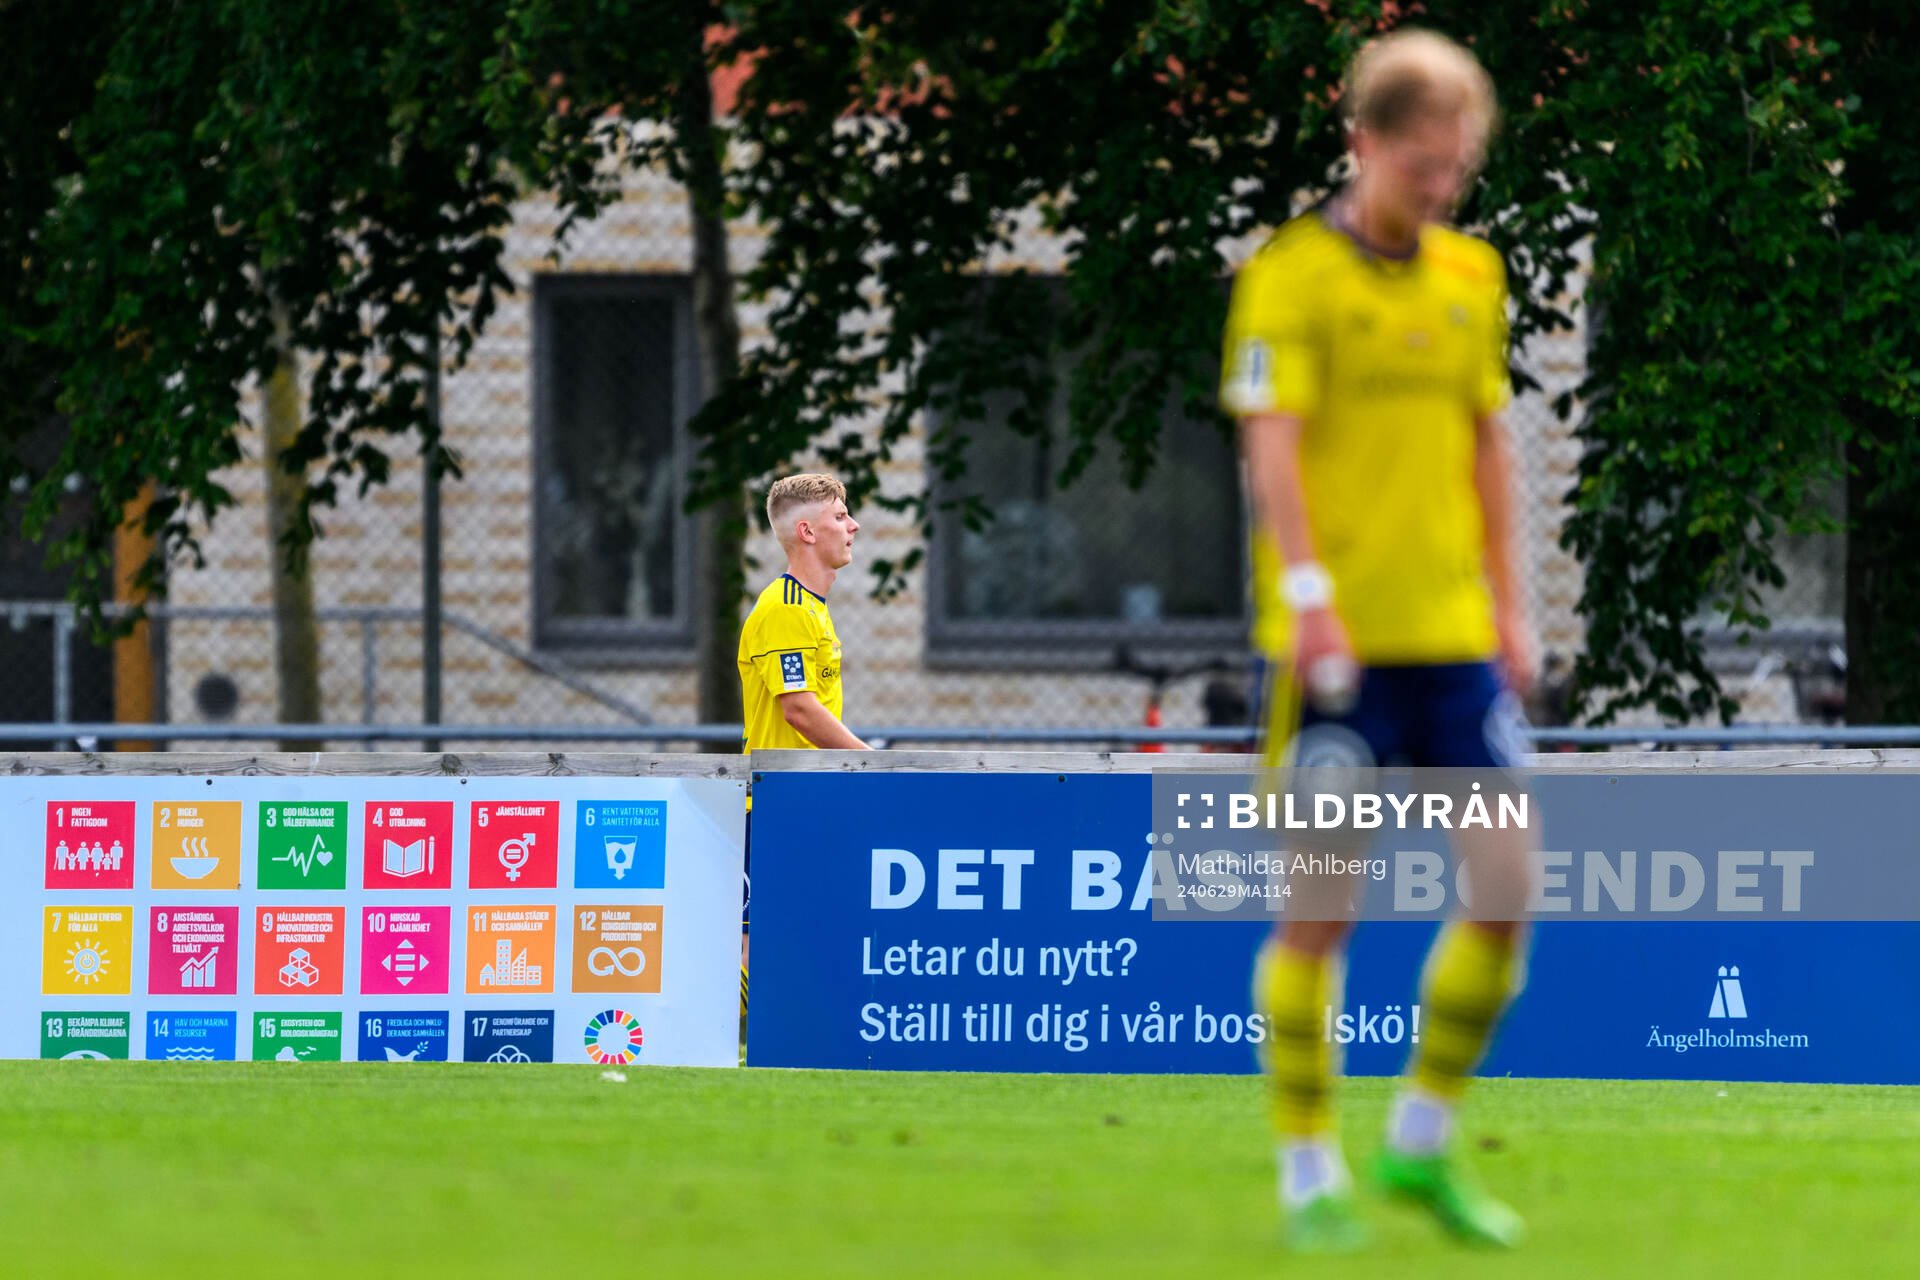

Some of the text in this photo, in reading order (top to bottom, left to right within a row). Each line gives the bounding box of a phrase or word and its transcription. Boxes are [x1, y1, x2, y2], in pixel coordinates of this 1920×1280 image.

[56, 808, 63, 827] 1
[72, 808, 91, 816] INGEN
[160, 808, 170, 827] 2
[266, 808, 276, 827] 3
[283, 806, 334, 816] GOD HÄLSA OCH
[372, 808, 383, 827] 4
[390, 808, 403, 816] GOD
[478, 808, 488, 827] 5
[496, 806, 545, 816] JÄMSTÄLLDHET
[586, 808, 595, 826] 6
[71, 818, 108, 827] FATTIGDOM
[602, 818, 629, 826] SANITET
[643, 818, 660, 826] ALLA
[871, 832, 1814, 912] DET BÄST BENDET
[52, 912, 61, 932] 7
[157, 912, 168, 932] 8
[173, 912, 214, 921] ANSTÄNDIGA
[262, 912, 273, 932] 9
[277, 912, 304, 922] HÅLLBAR
[368, 913, 386, 932] 10
[473, 912, 486, 932] 11
[580, 912, 596, 931] 12
[173, 924, 224, 932] ARBETSVILLKOR
[172, 934, 224, 942] OCH EKONOMISK
[276, 934, 325, 942] INFRASTRUKTUR
[172, 944, 201, 953] TILLVÄXT
[862, 937, 1138, 985] Letar du nytt?
[46, 1018, 63, 1037] 13
[68, 1017, 99, 1026] BEKÄMPA
[154, 1018, 168, 1037] 14
[175, 1018, 228, 1026] HAV OCH MARINA
[259, 1018, 276, 1038] 15
[365, 1019, 382, 1037] 16
[472, 1018, 488, 1036] 17
[860, 1002, 950, 1042] Ställ
[962, 1004, 1012, 1042] till
[1026, 1004, 1089, 1052] dig
[1101, 1004, 1109, 1042] i
[1121, 1001, 1184, 1042] vår
[175, 1029, 207, 1037] RESURSER
[413, 1029, 445, 1037] SAMHÄLLEN
[1646, 1025, 1809, 1053] Ängelholmshem
